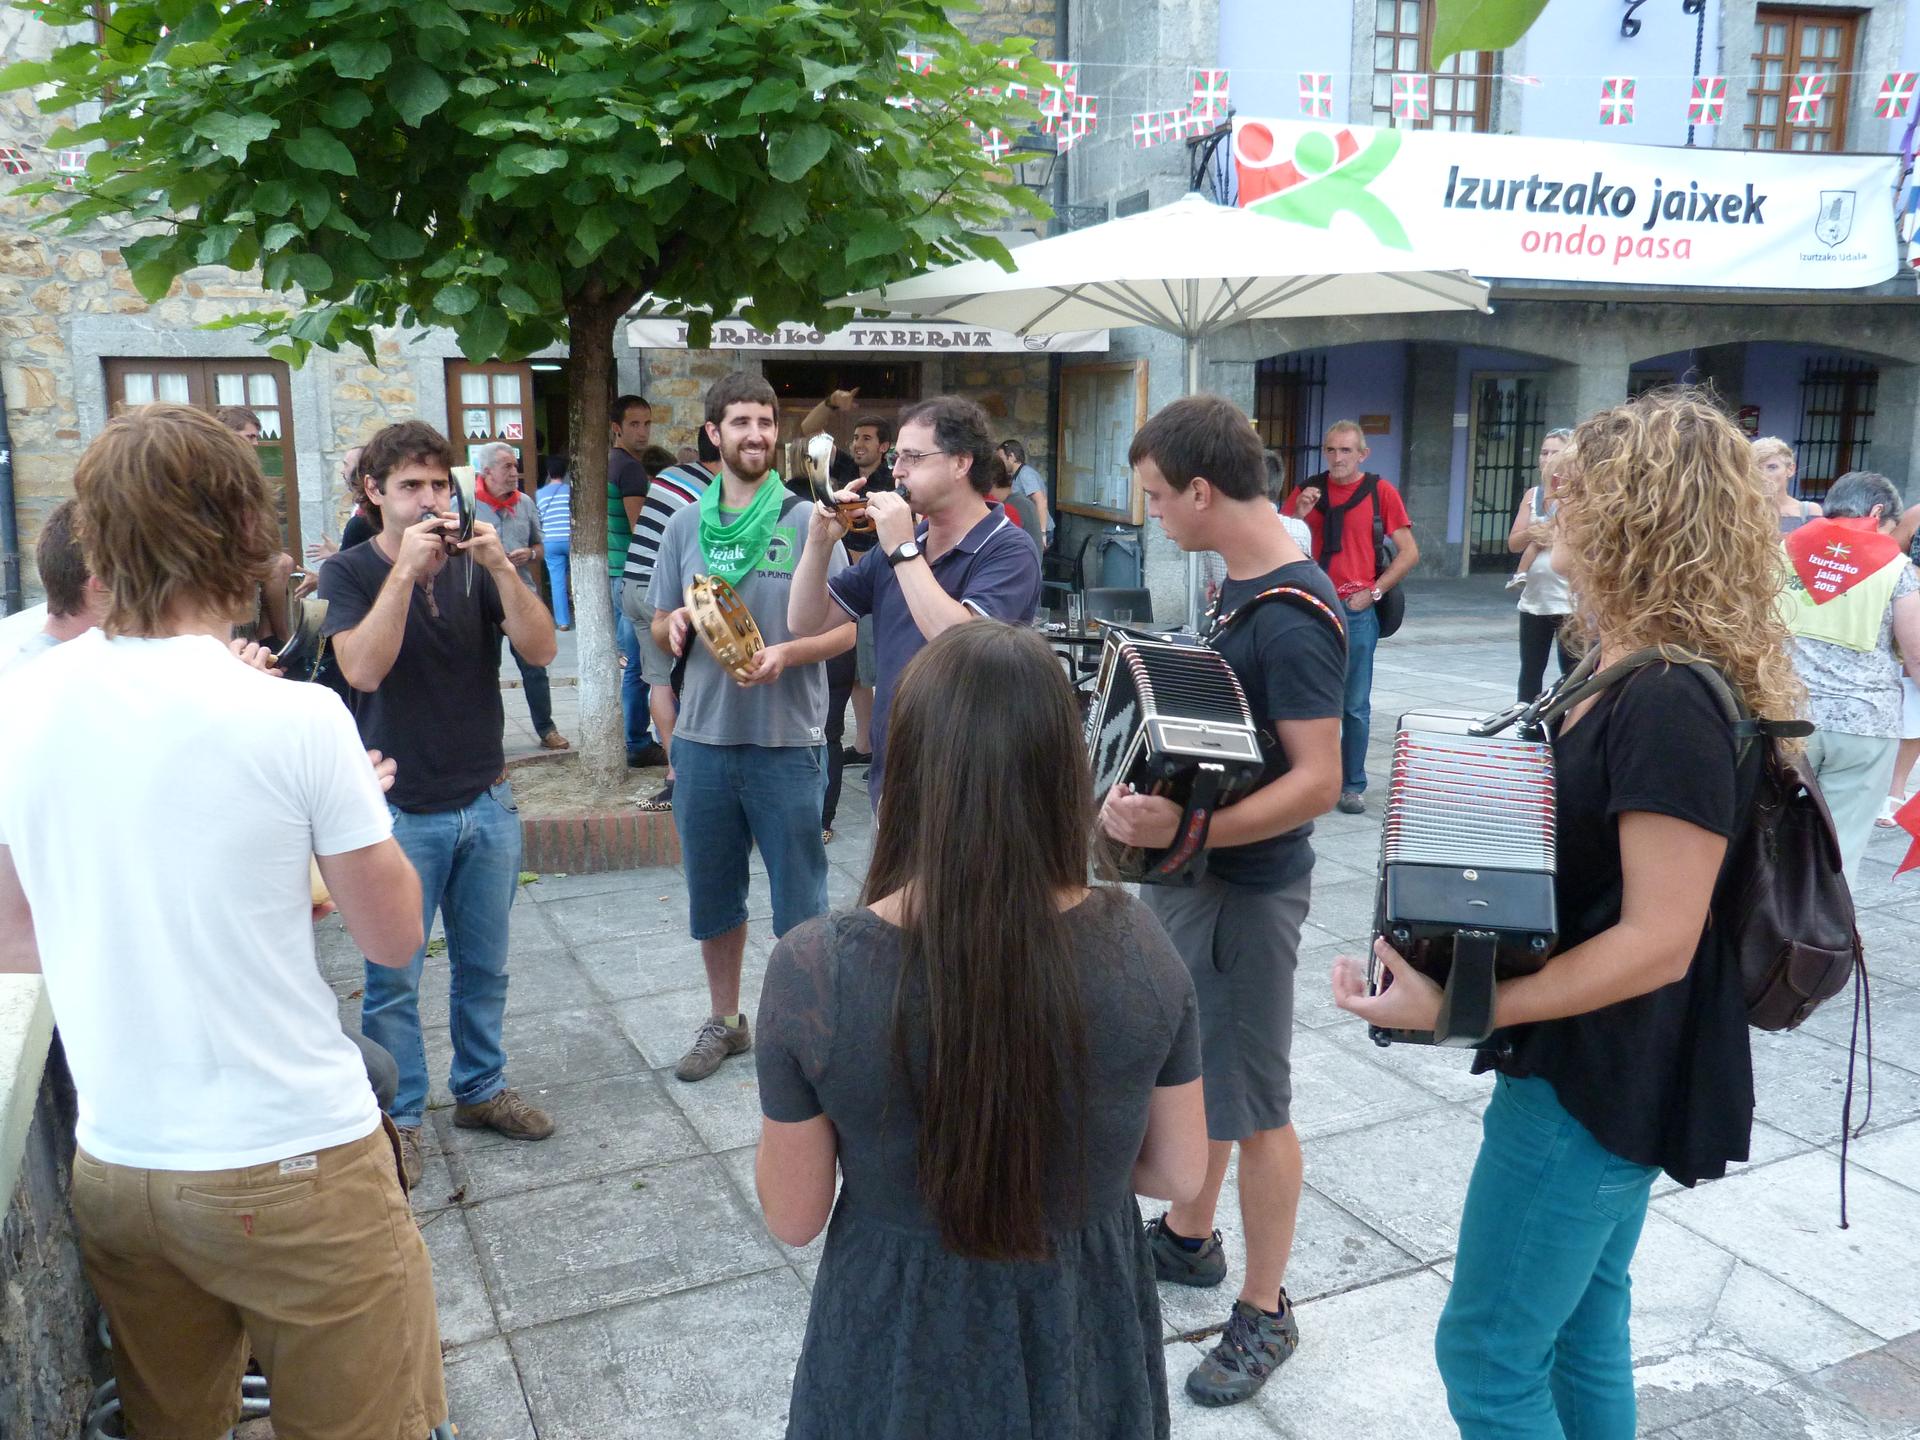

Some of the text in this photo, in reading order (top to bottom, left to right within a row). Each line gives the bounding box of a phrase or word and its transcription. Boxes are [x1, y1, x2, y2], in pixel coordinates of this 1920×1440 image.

[1443, 165, 1768, 231] Izurtzako jaixek
[1520, 223, 1692, 265] ondo pasa
[1799, 252, 1837, 262] Izurtzako
[850, 330, 992, 347] TABERNA
[1814, 569, 1843, 583] jaiak
[1814, 581, 1836, 593] 2013
